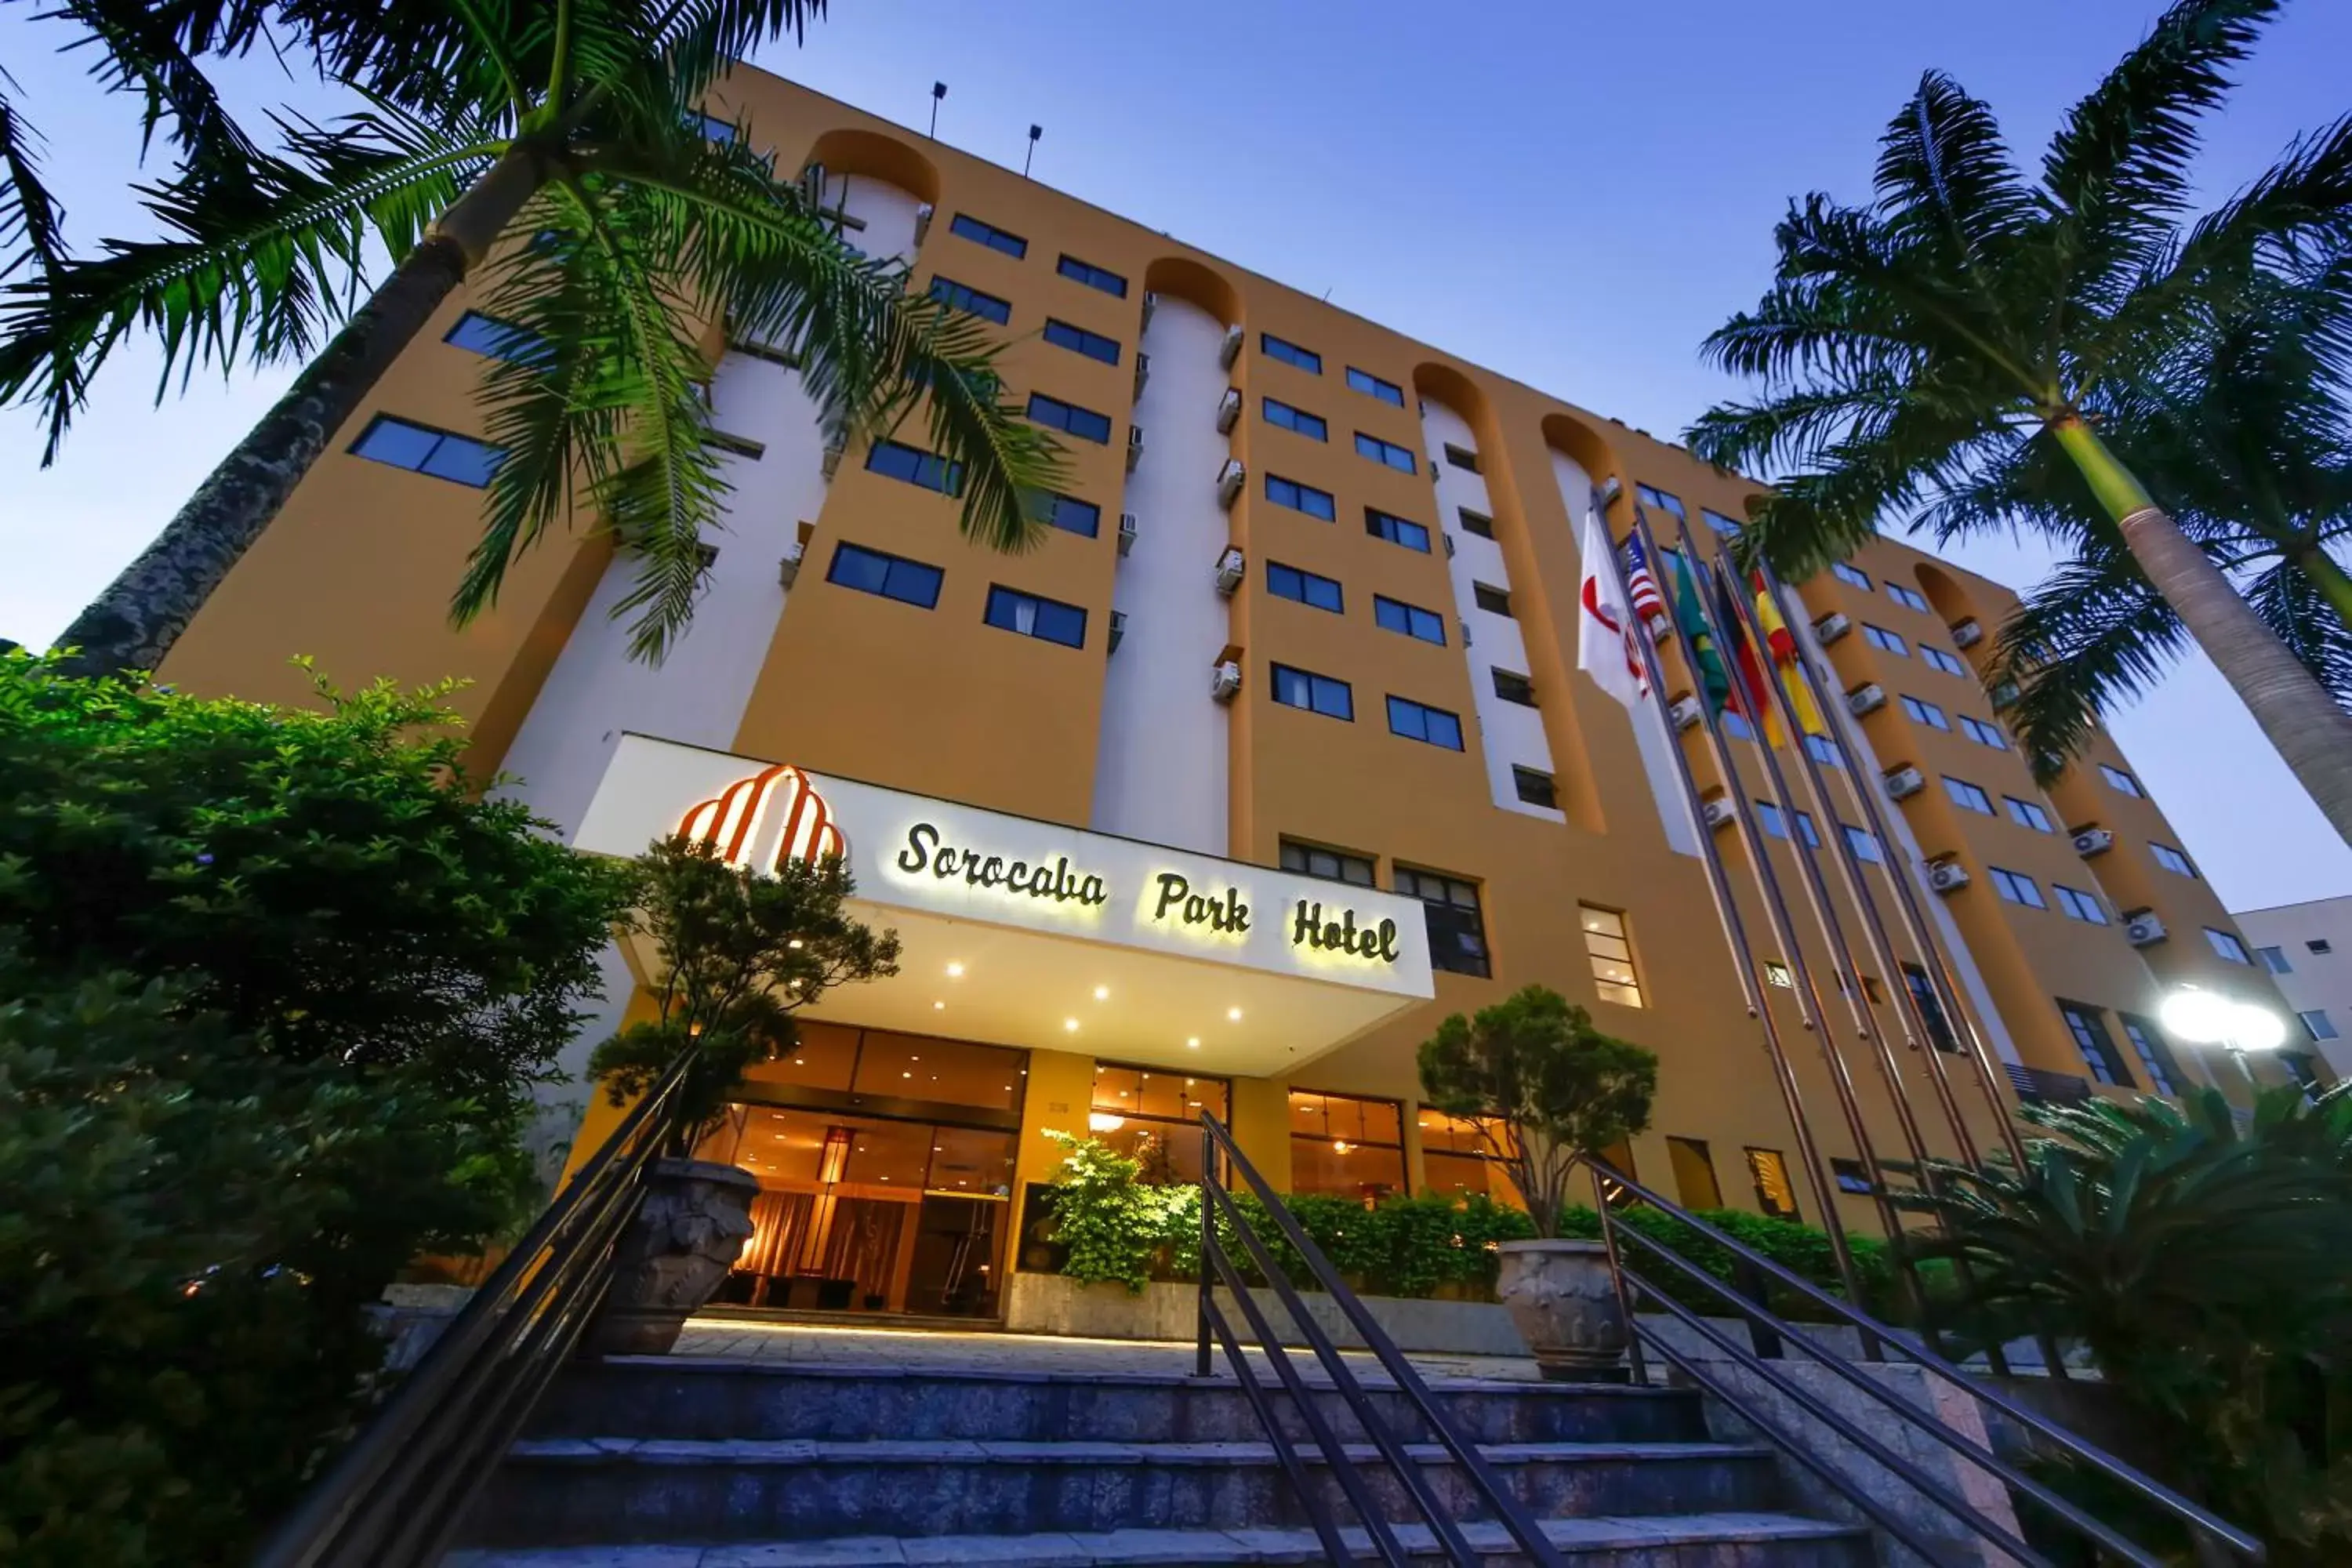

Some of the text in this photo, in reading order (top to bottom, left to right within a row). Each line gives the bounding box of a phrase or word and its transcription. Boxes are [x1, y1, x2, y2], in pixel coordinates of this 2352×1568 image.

[898, 822, 1399, 963] Sorocaba Park Hotel
